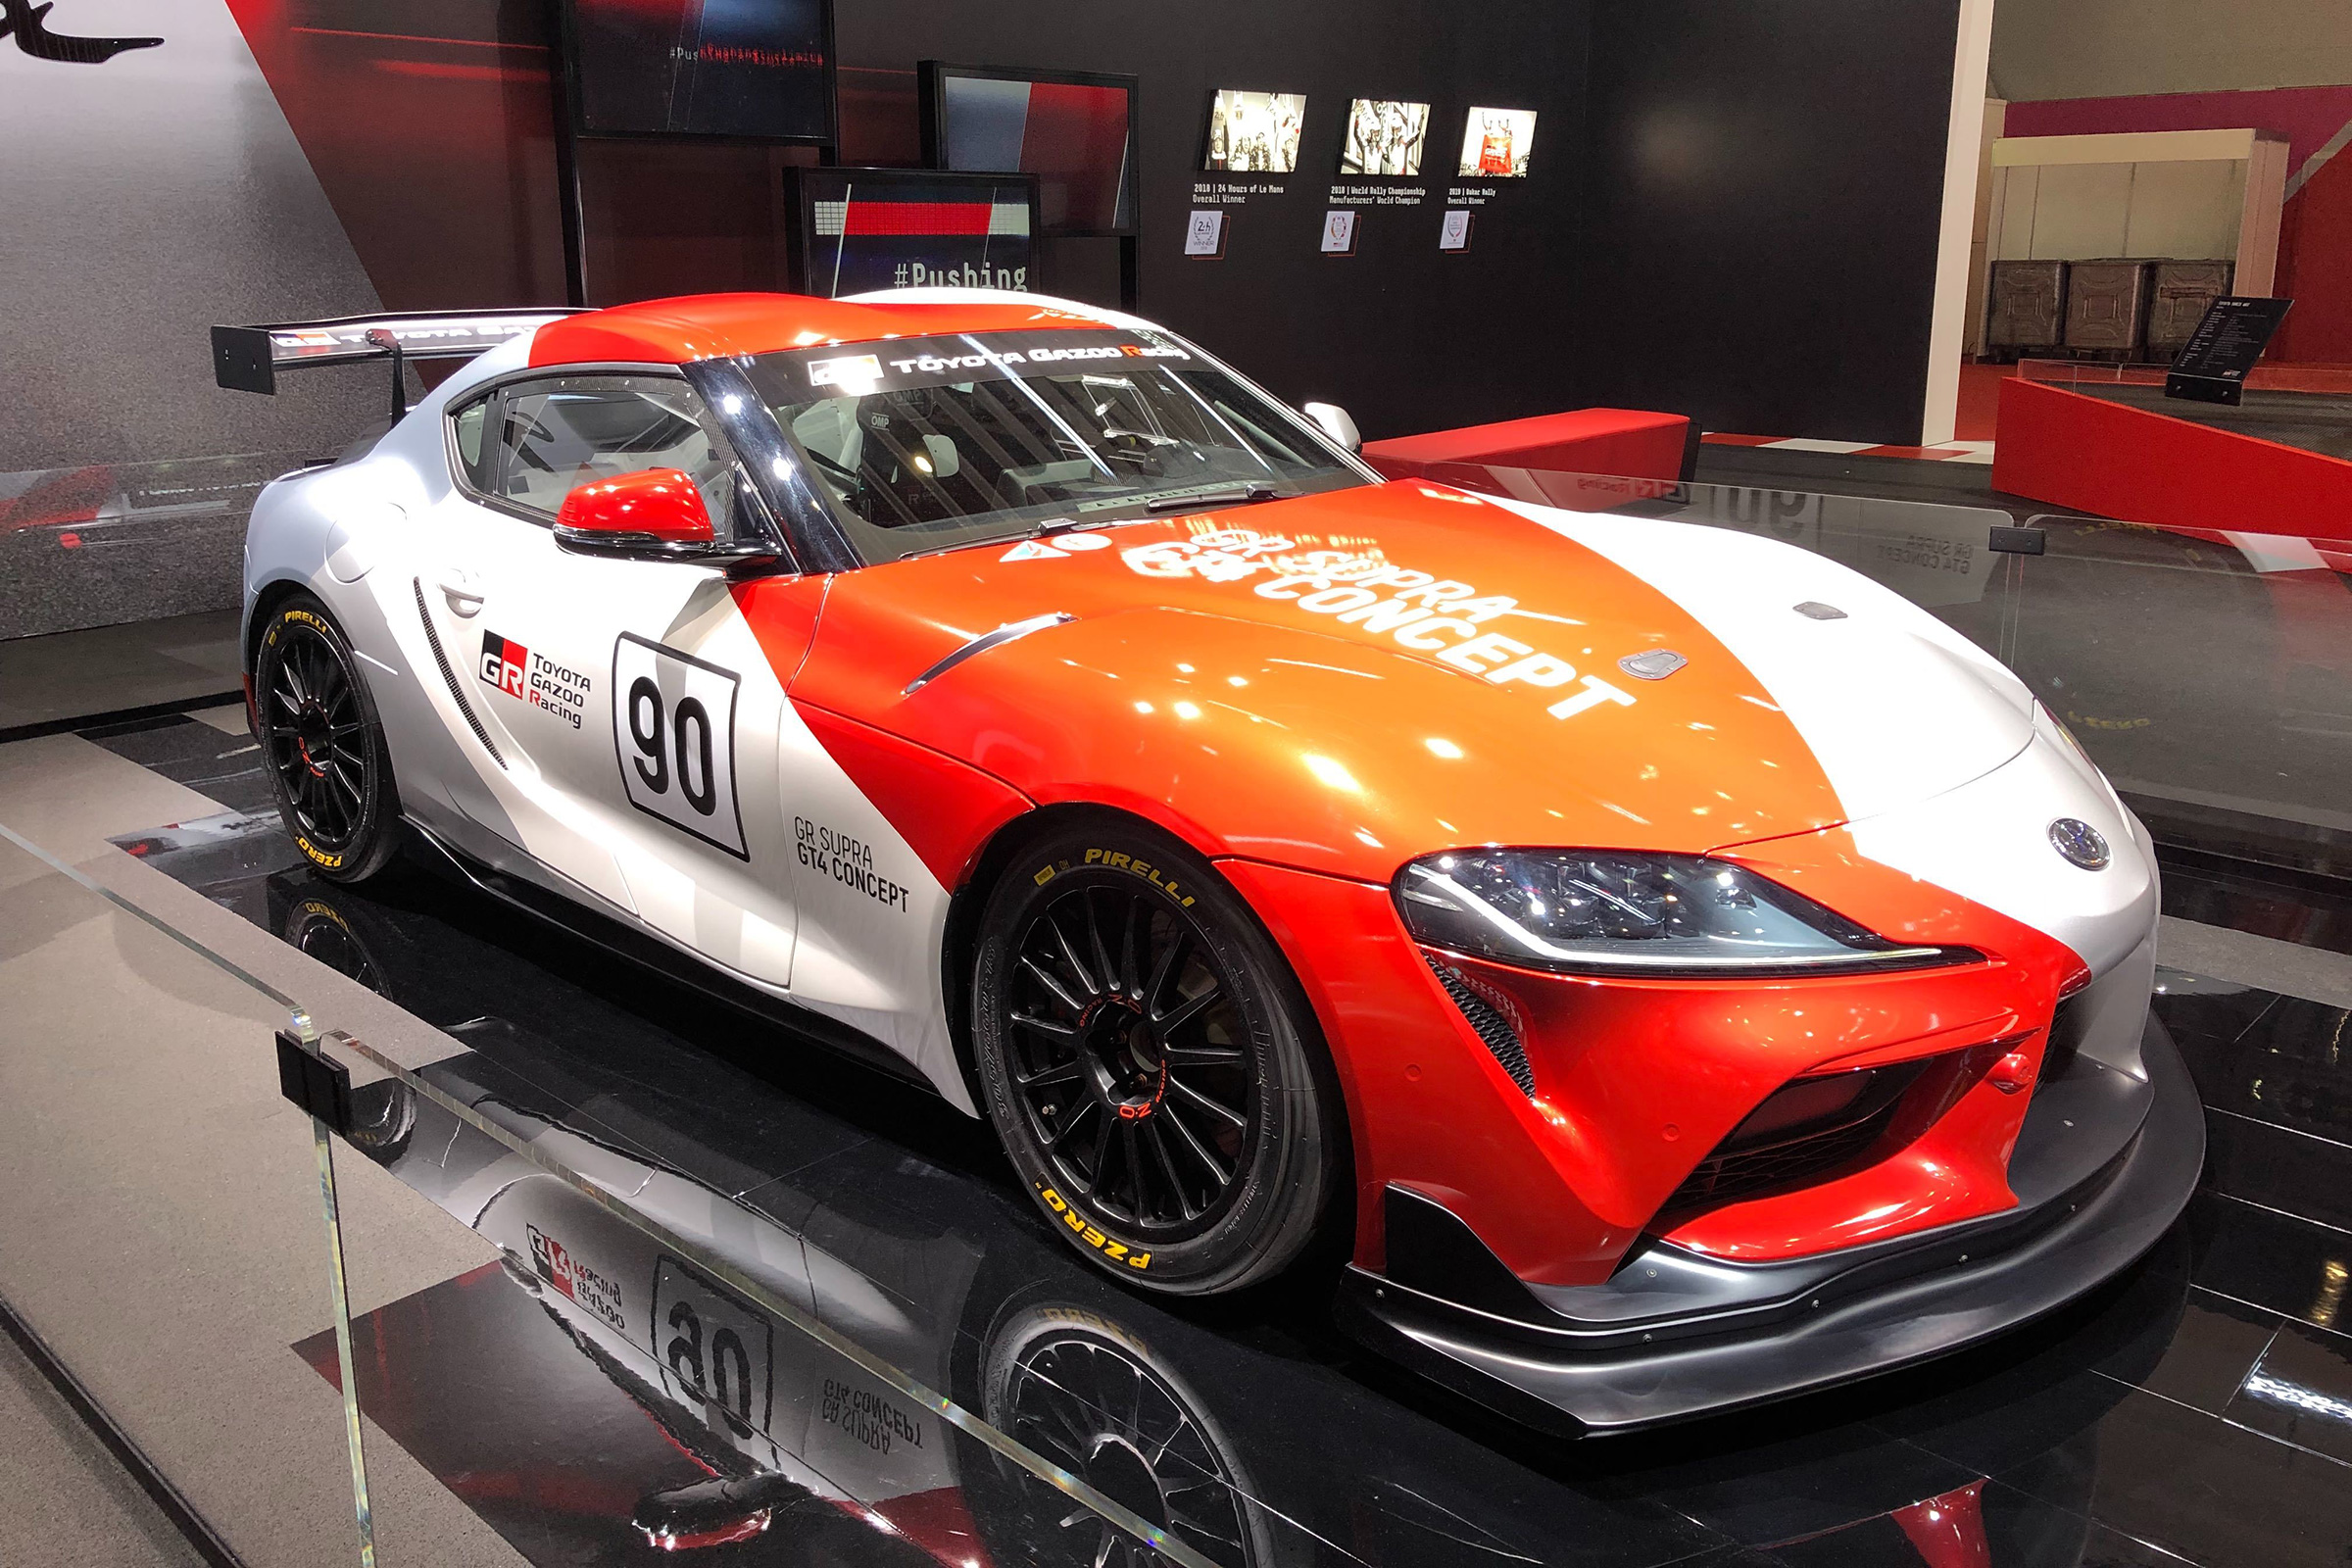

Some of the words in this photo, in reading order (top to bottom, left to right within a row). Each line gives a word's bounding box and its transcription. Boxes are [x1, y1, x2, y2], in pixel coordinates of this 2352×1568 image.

[1192, 194, 1221, 204] Overall
[1222, 194, 1246, 204] Winner
[1228, 184, 1248, 194] Hours
[1250, 184, 1257, 194] of
[1259, 185, 1267, 194] Le
[1350, 186, 1369, 195] World
[1369, 186, 1387, 197] Rally
[1388, 187, 1426, 197] Championship
[1376, 196, 1394, 205] World
[1395, 196, 1421, 207] Champion
[339, 327, 473, 344] TYOTA
[889, 352, 1027, 374] TOYOTA
[1028, 348, 1124, 363] GAZOO
[871, 415, 890, 428] OMP
[284, 610, 327, 634] PIRELLI
[1253, 574, 1638, 720] CONCEPT
[478, 651, 525, 697] GR
[529, 672, 585, 709] GAZOO
[532, 652, 592, 693] TOYOTA
[528, 688, 582, 731] Racing
[628, 675, 717, 817] 90
[794, 815, 816, 846] GR
[819, 821, 873, 870] SUPRA
[797, 842, 828, 876] GT4
[831, 855, 909, 913] CONCEPT
[1084, 848, 1195, 907] PIRELLI
